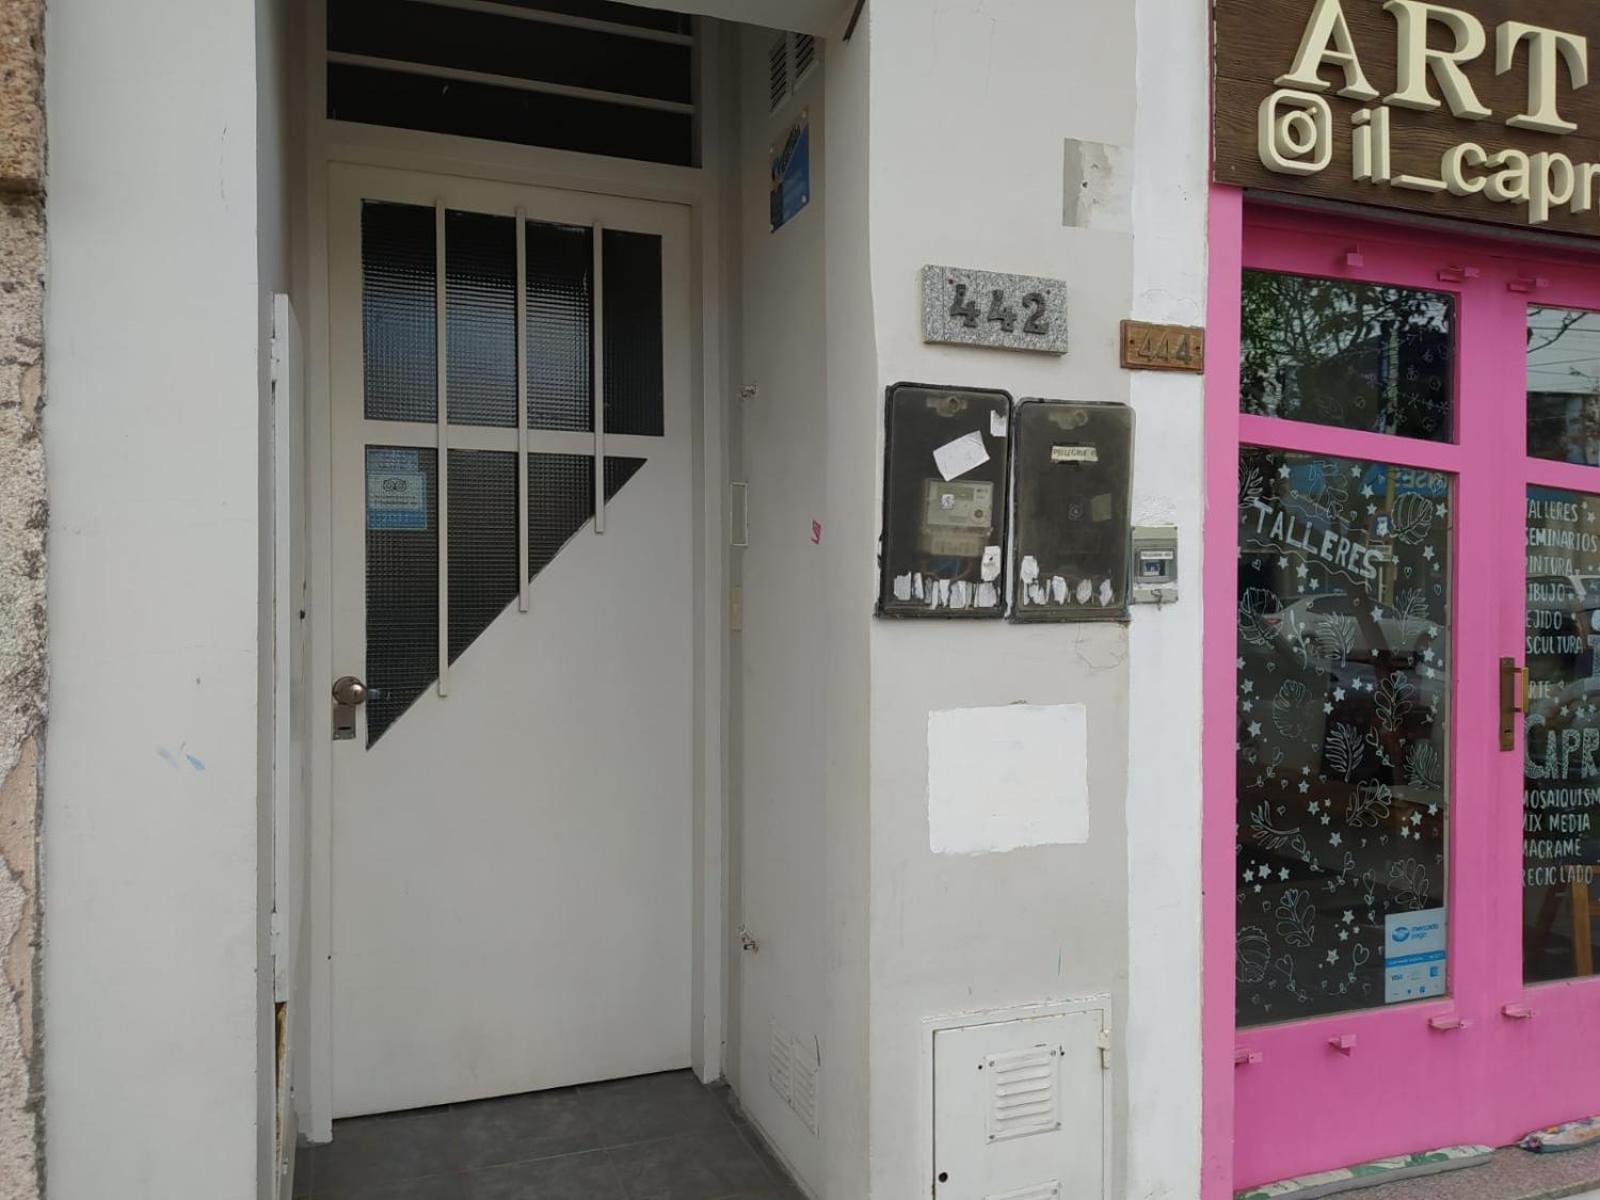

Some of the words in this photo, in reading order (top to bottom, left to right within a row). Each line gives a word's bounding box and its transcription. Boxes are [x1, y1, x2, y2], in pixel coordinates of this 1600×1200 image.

[1274, 0, 1588, 135] ART
[950, 284, 1050, 335] 442
[1137, 329, 1193, 366] 444
[1249, 497, 1384, 580] TALLERES
[1526, 582, 1566, 602] IBUJO
[1526, 609, 1563, 630] EJIDO
[1526, 635, 1584, 655] SCULTURA
[1528, 680, 1551, 699] RTE
[1549, 813, 1591, 833] MEDIA
